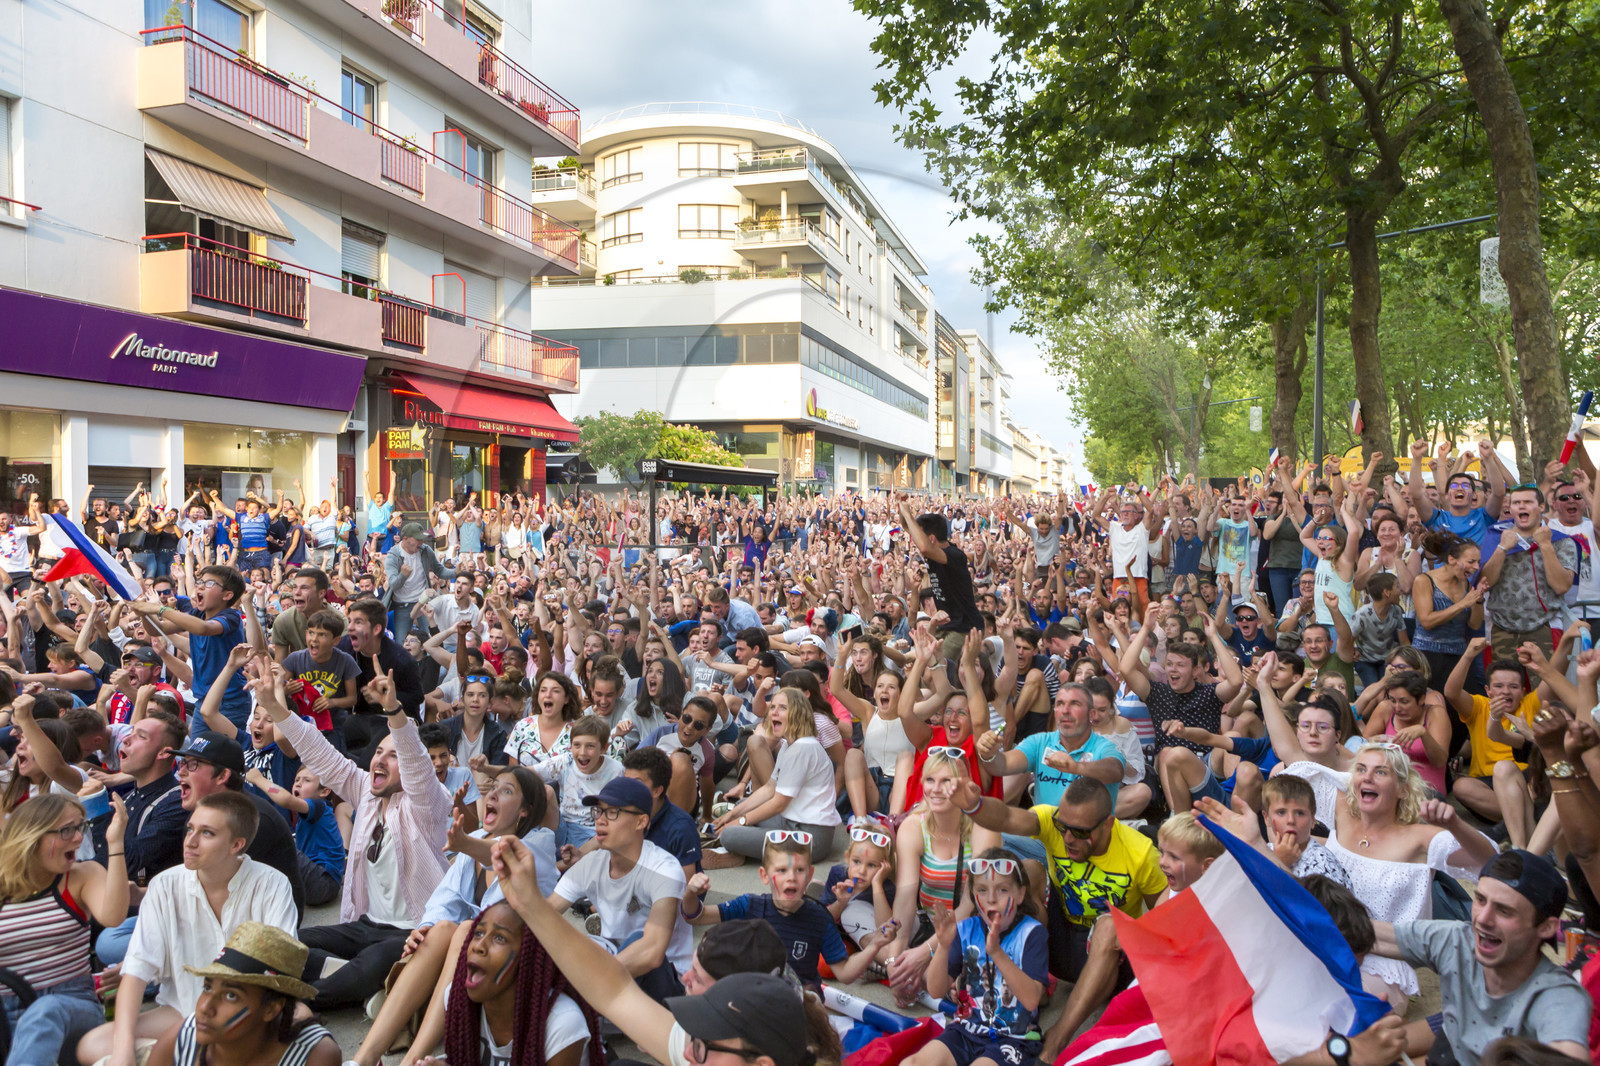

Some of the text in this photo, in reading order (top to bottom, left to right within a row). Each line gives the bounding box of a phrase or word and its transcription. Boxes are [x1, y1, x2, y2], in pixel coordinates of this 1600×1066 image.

[110, 332, 219, 368] Marionnaud
[152, 363, 178, 374] PARIS
[388, 431, 410, 440] PAM
[388, 440, 410, 449] PAM
[17, 473, 40, 484] -50%
[298, 670, 341, 689] OOTBALL
